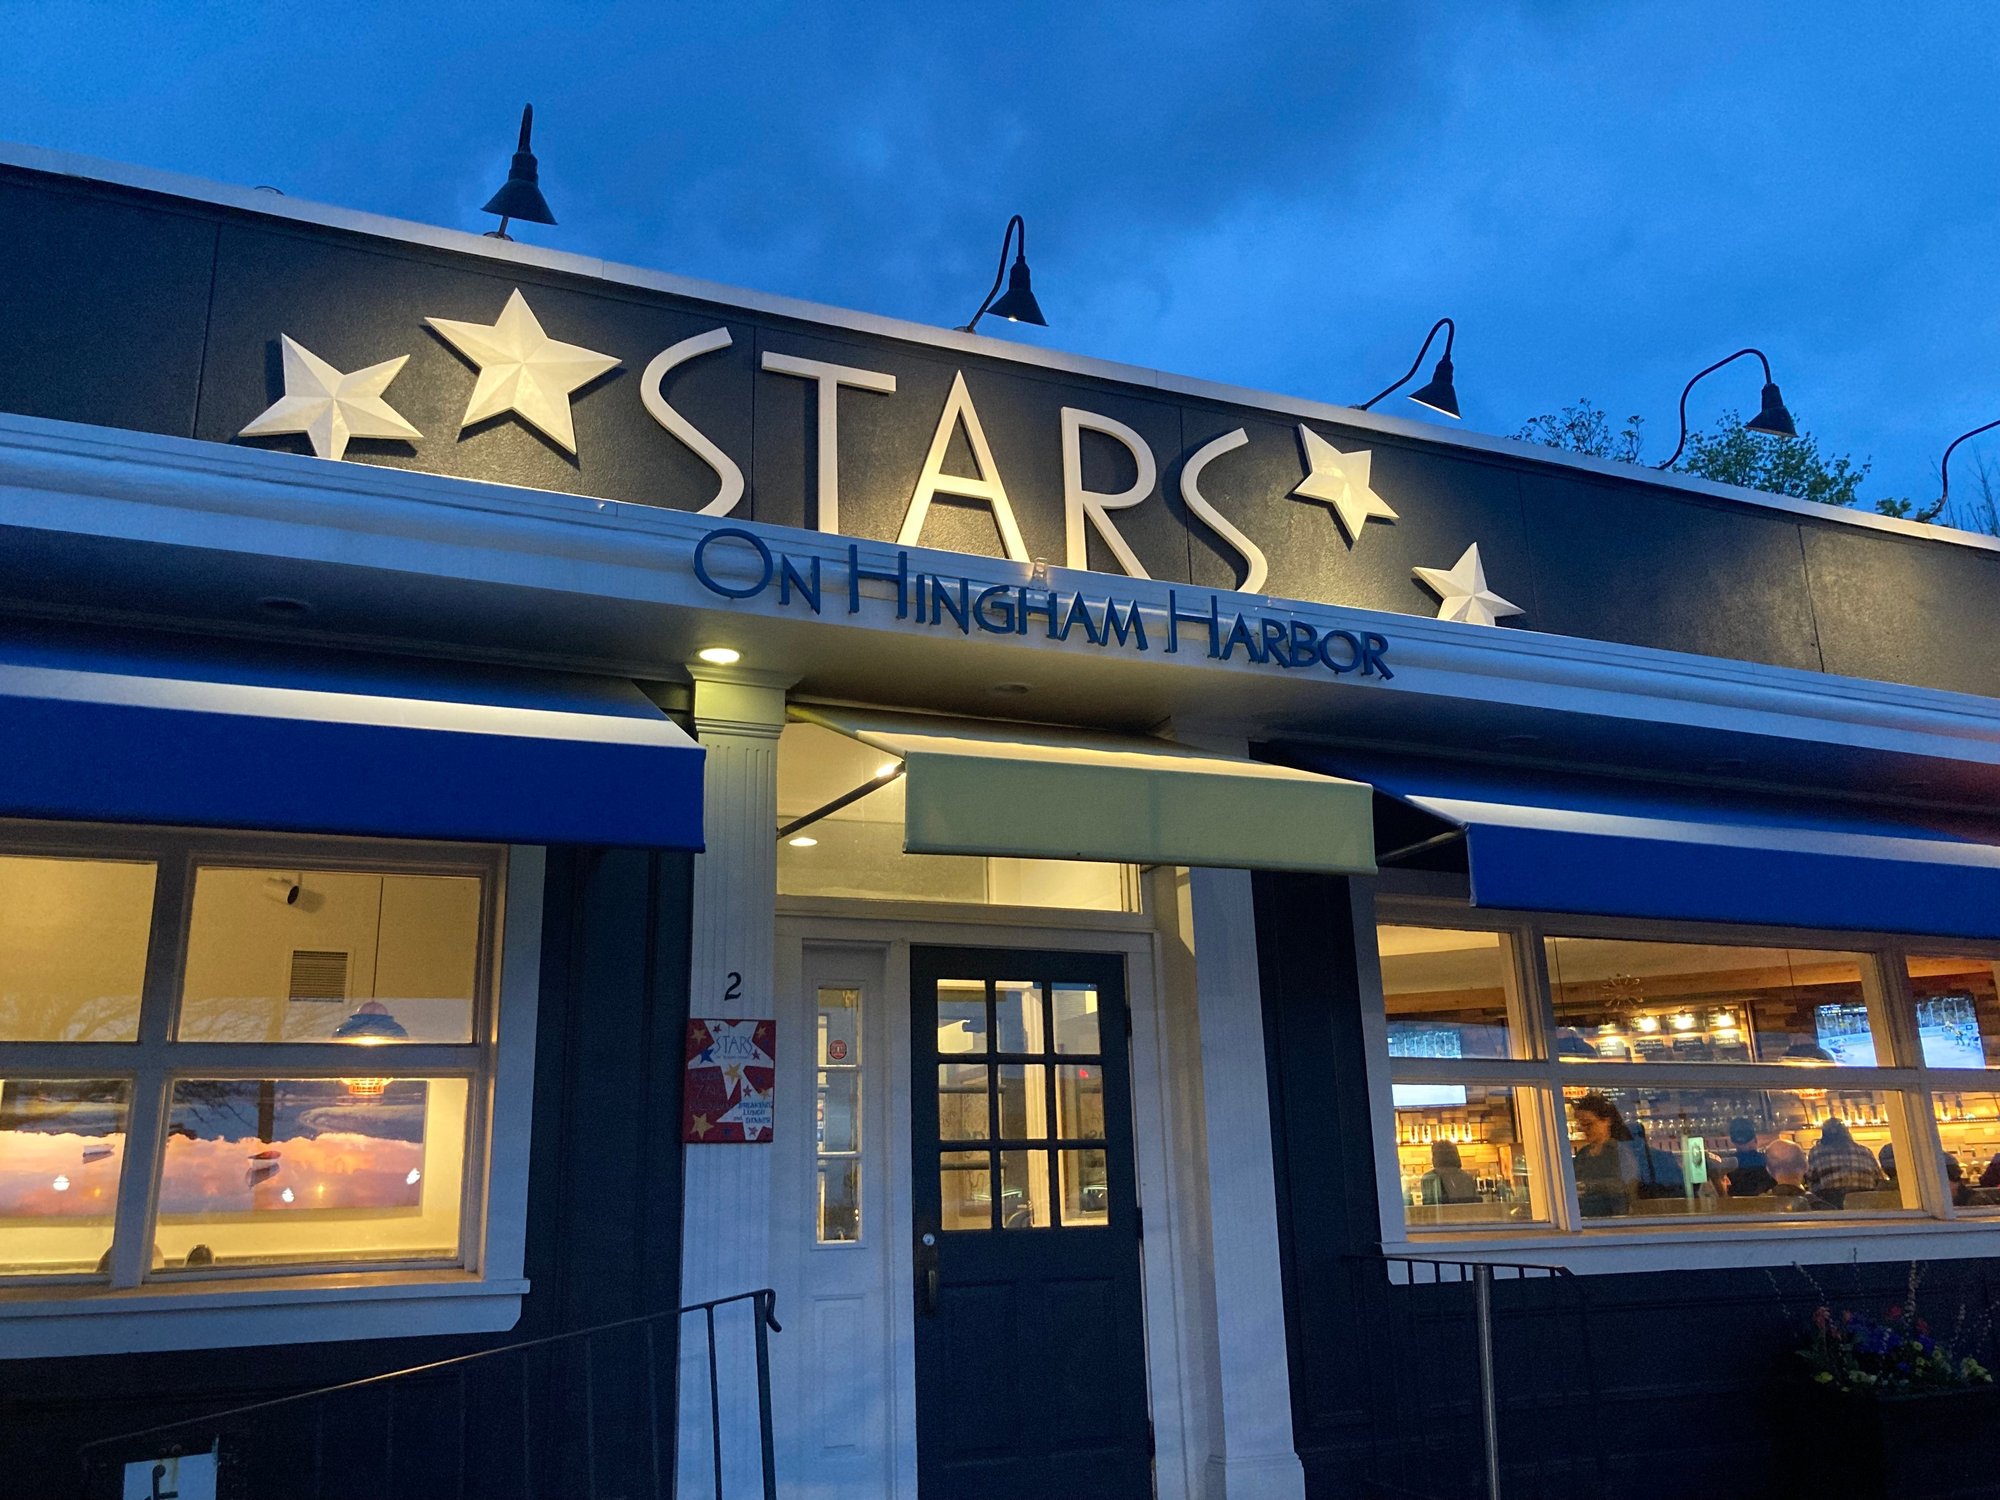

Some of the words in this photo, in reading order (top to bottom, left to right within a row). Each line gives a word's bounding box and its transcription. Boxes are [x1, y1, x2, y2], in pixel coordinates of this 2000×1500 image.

[640, 326, 1269, 595] STARS
[724, 971, 742, 1001] 2
[714, 1035, 753, 1056] STARS
